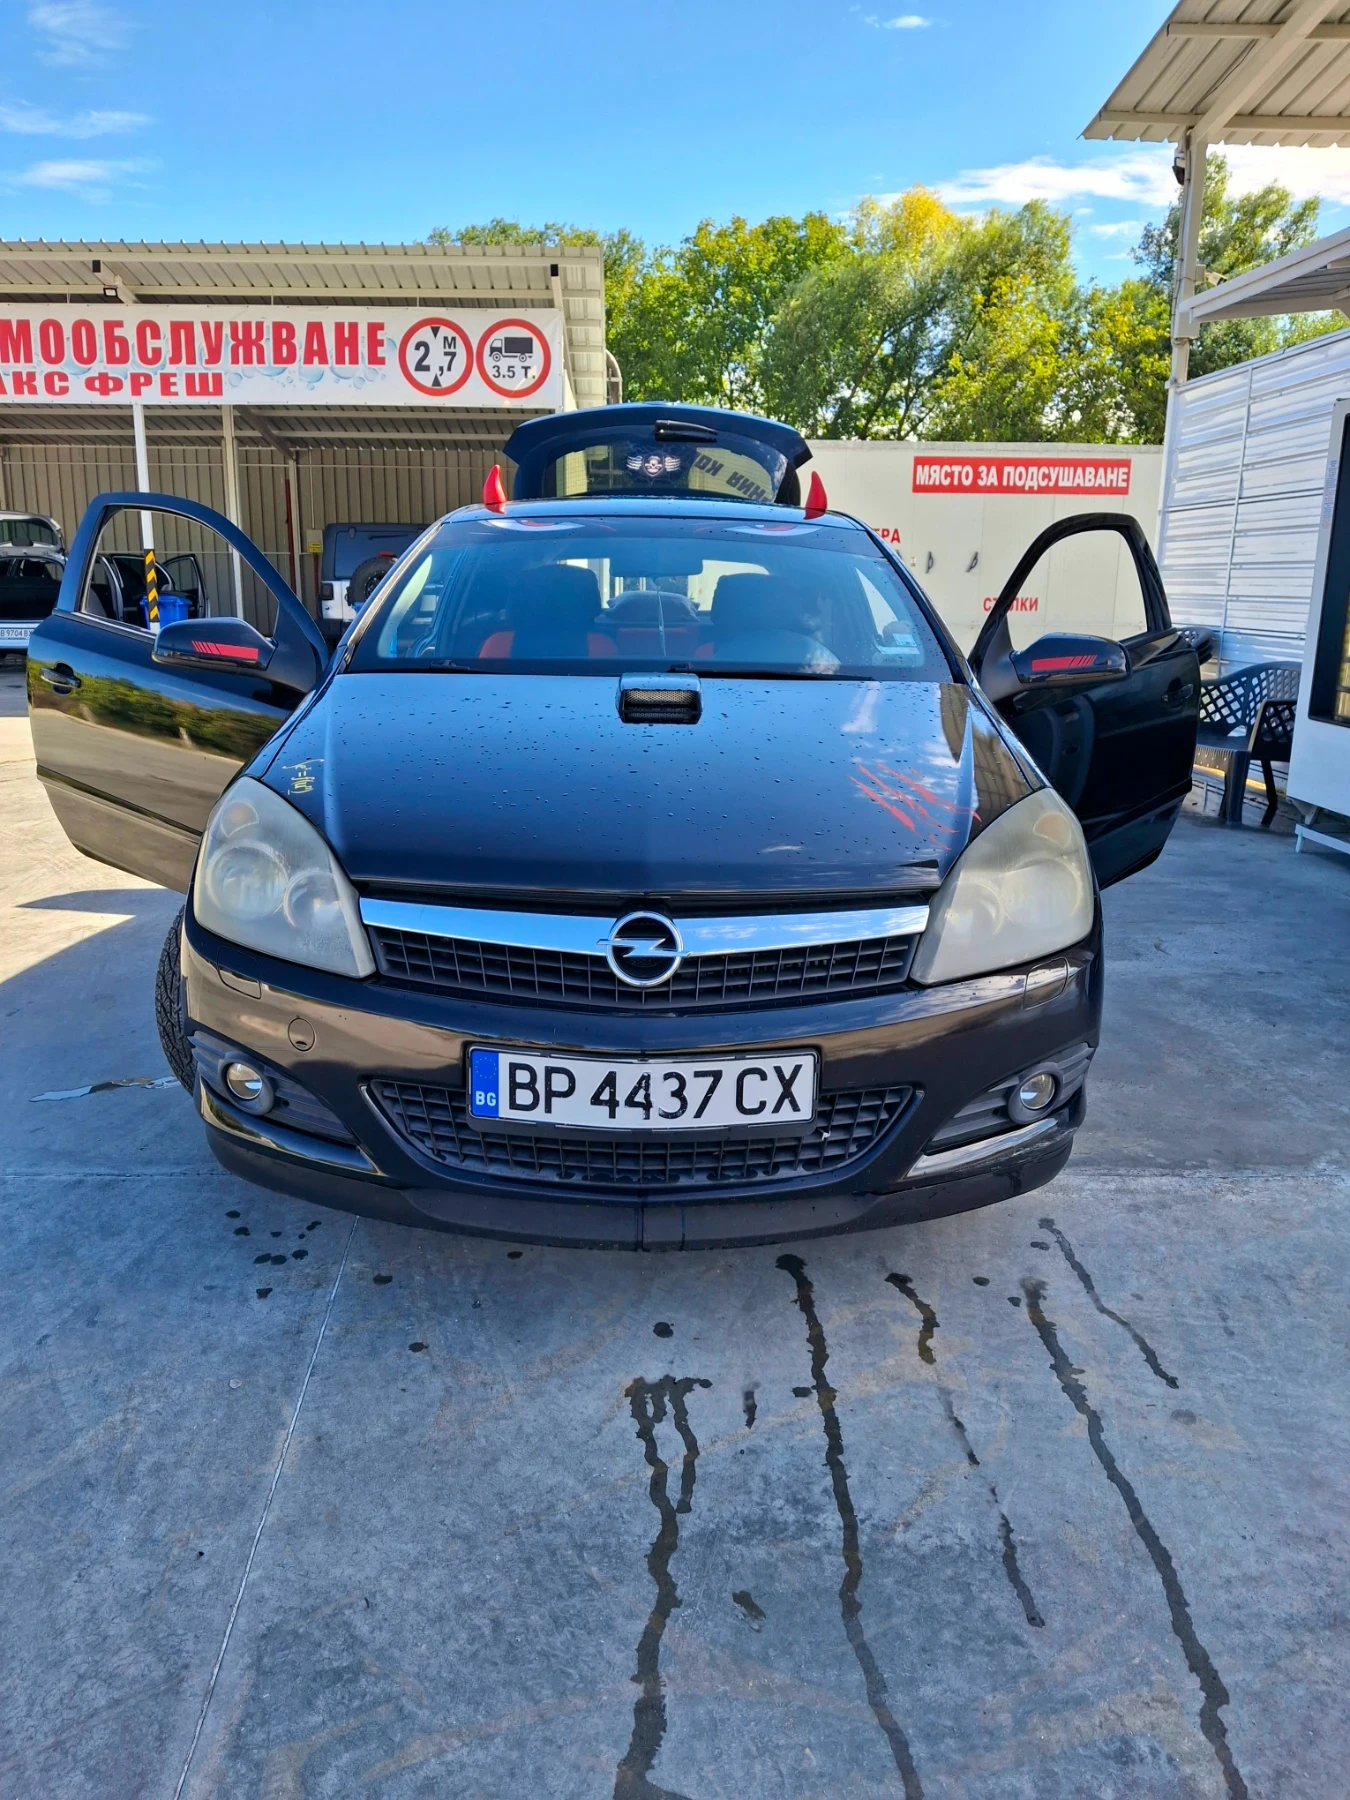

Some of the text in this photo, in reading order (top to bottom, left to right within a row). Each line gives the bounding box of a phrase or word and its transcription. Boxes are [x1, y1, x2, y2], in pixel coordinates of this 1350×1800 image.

[0, 319, 386, 366] МООБСЛУЖВАНЕ
[84, 372, 224, 397] ФРЕШ
[492, 365, 516, 379] 3.5
[725, 471, 773, 502] НИЯ
[915, 464, 1129, 491] МЯСТО ЗА ПОДСУШАВАНЕ
[475, 1061, 804, 1121] BG BP 4437 CX
